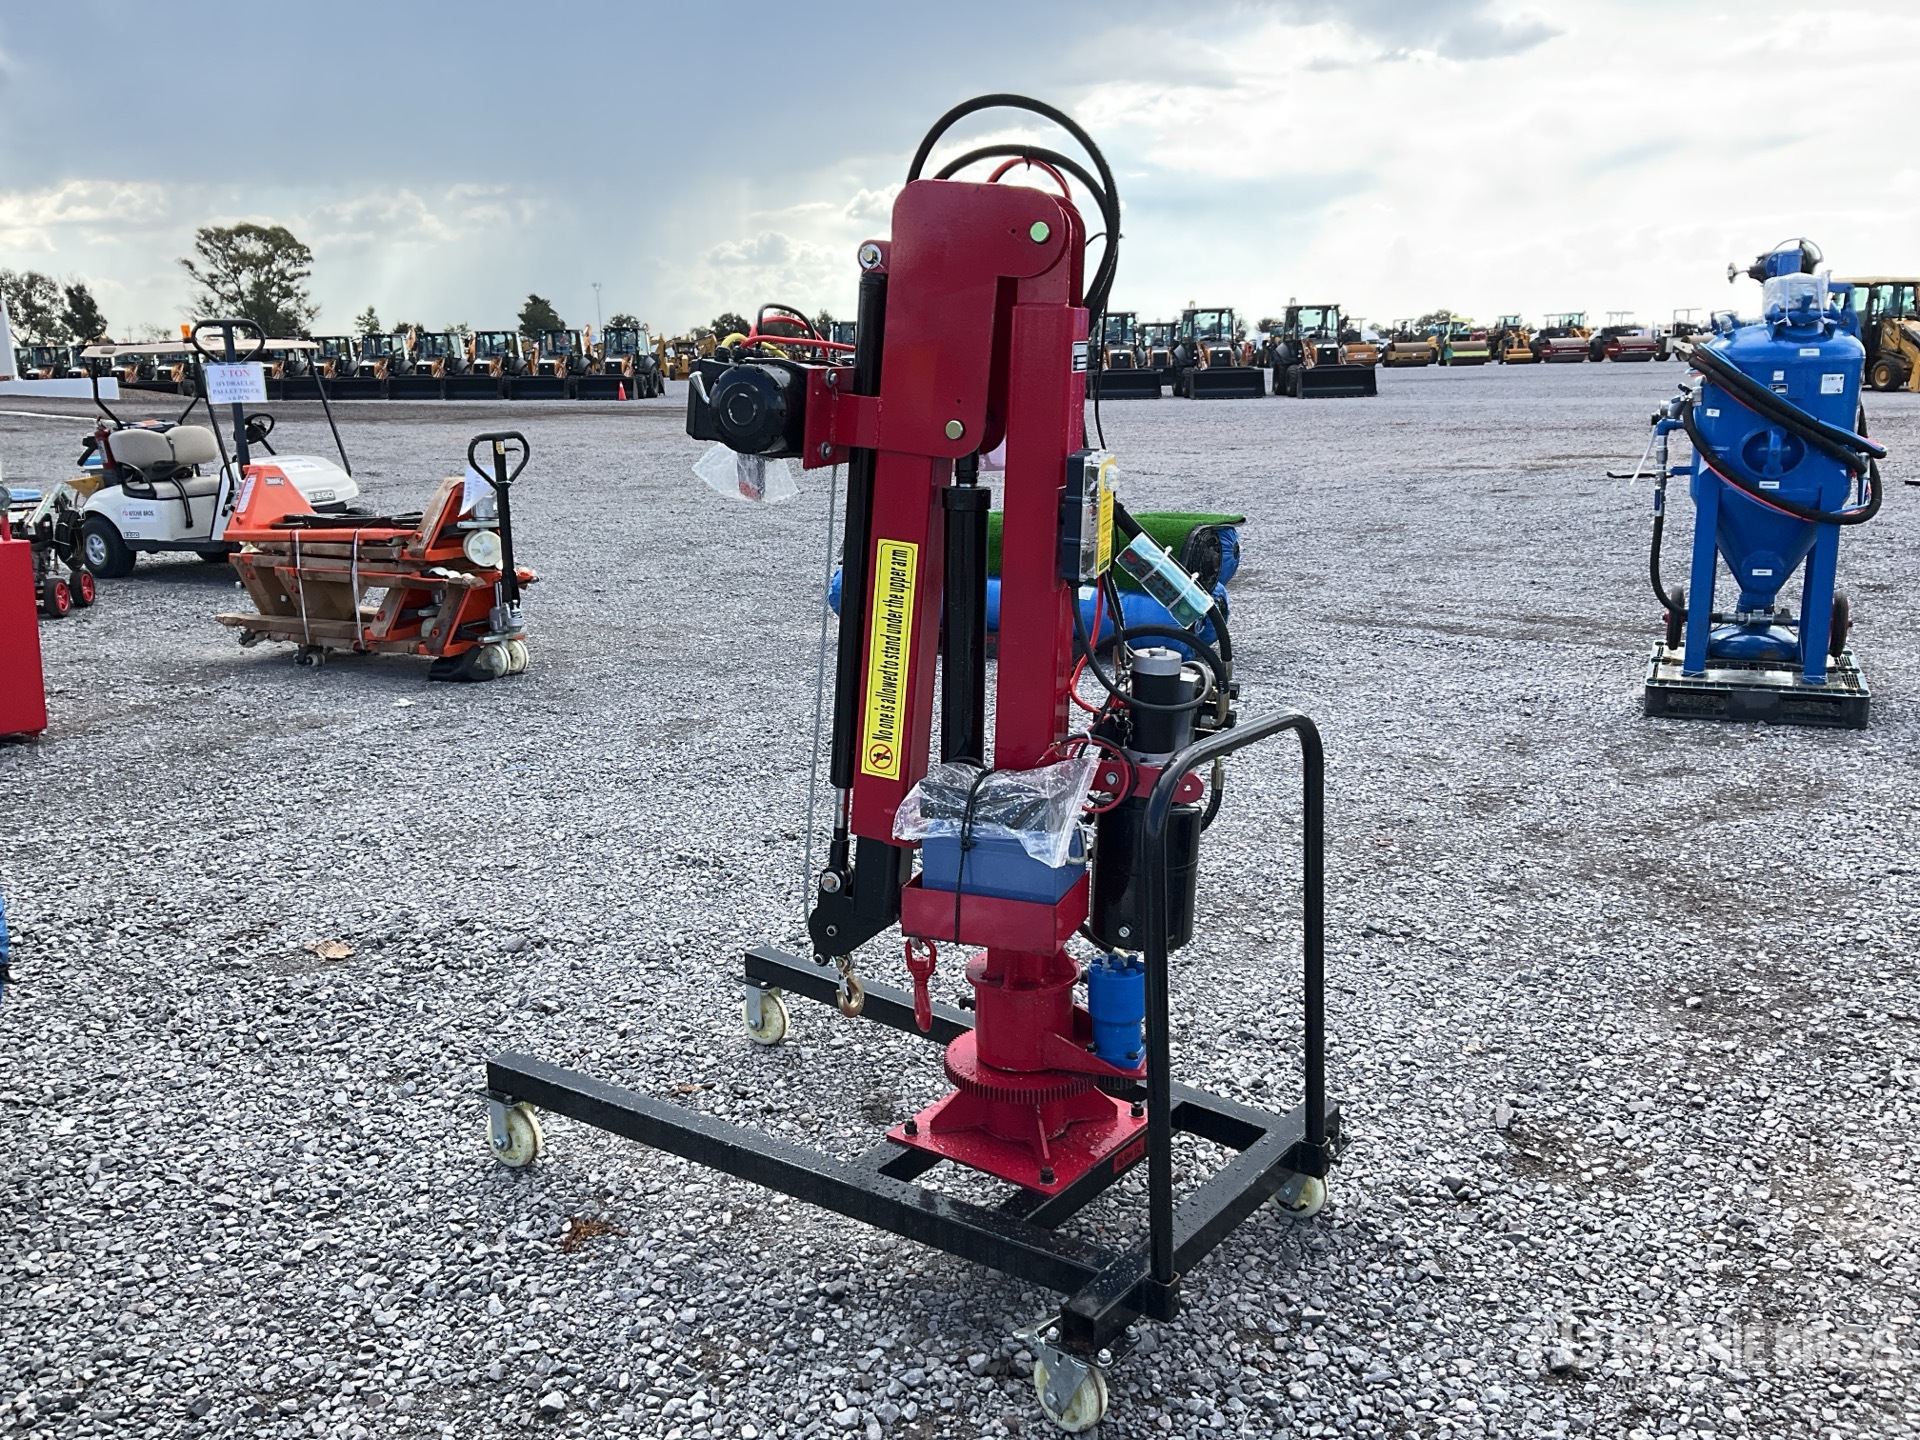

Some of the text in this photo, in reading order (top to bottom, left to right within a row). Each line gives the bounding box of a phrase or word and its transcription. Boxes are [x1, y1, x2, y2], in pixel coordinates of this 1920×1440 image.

[220, 369, 251, 377] 3 TON
[872, 549, 911, 743] No one is allowed to stand under the upper arm
